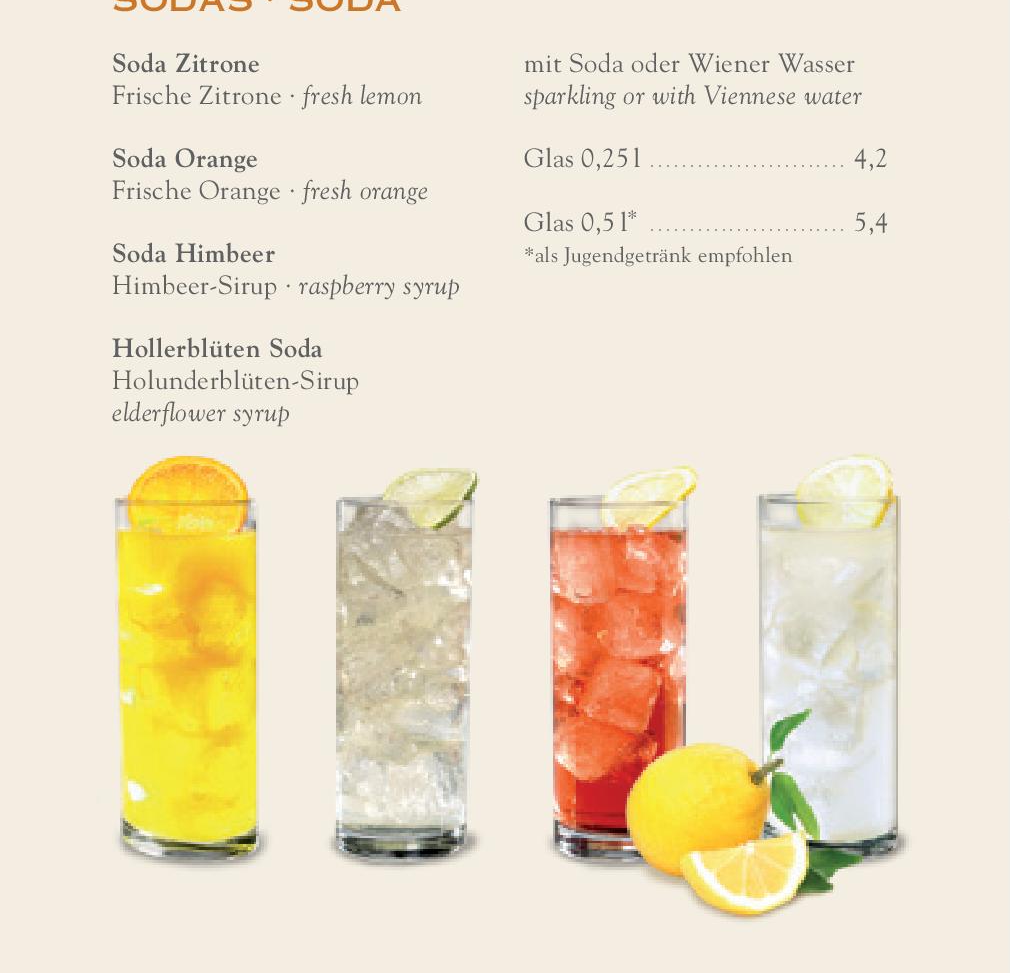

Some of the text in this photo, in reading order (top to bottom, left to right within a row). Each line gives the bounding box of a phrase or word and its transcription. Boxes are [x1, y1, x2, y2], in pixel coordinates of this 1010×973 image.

[113, 52, 259, 74] Soda Zitrone
[525, 52, 855, 74] mit Soda oder Wiener Wasser
[112, 84, 423, 110] Frische Zitrone fresh lemon
[524, 84, 862, 110] sparkling or with Viennese water
[113, 147, 257, 173] Soda Orange
[524, 147, 573, 168] Glas
[854, 148, 887, 171] 4,2
[113, 179, 427, 205] Frische Orange fresh orange
[524, 211, 573, 232] Glas
[855, 212, 887, 235] 5,4
[113, 242, 275, 263] Soda Himbeer
[563, 246, 692, 268] Jugendgetränk
[698, 246, 792, 267] empfohlen
[113, 274, 459, 300] Himbeer-Sirup raspberry syrup
[112, 337, 323, 358] Hollerblüten Soda
[113, 369, 358, 395] Holunderblüten-Sirup
[112, 401, 289, 427] elderflower syrup
